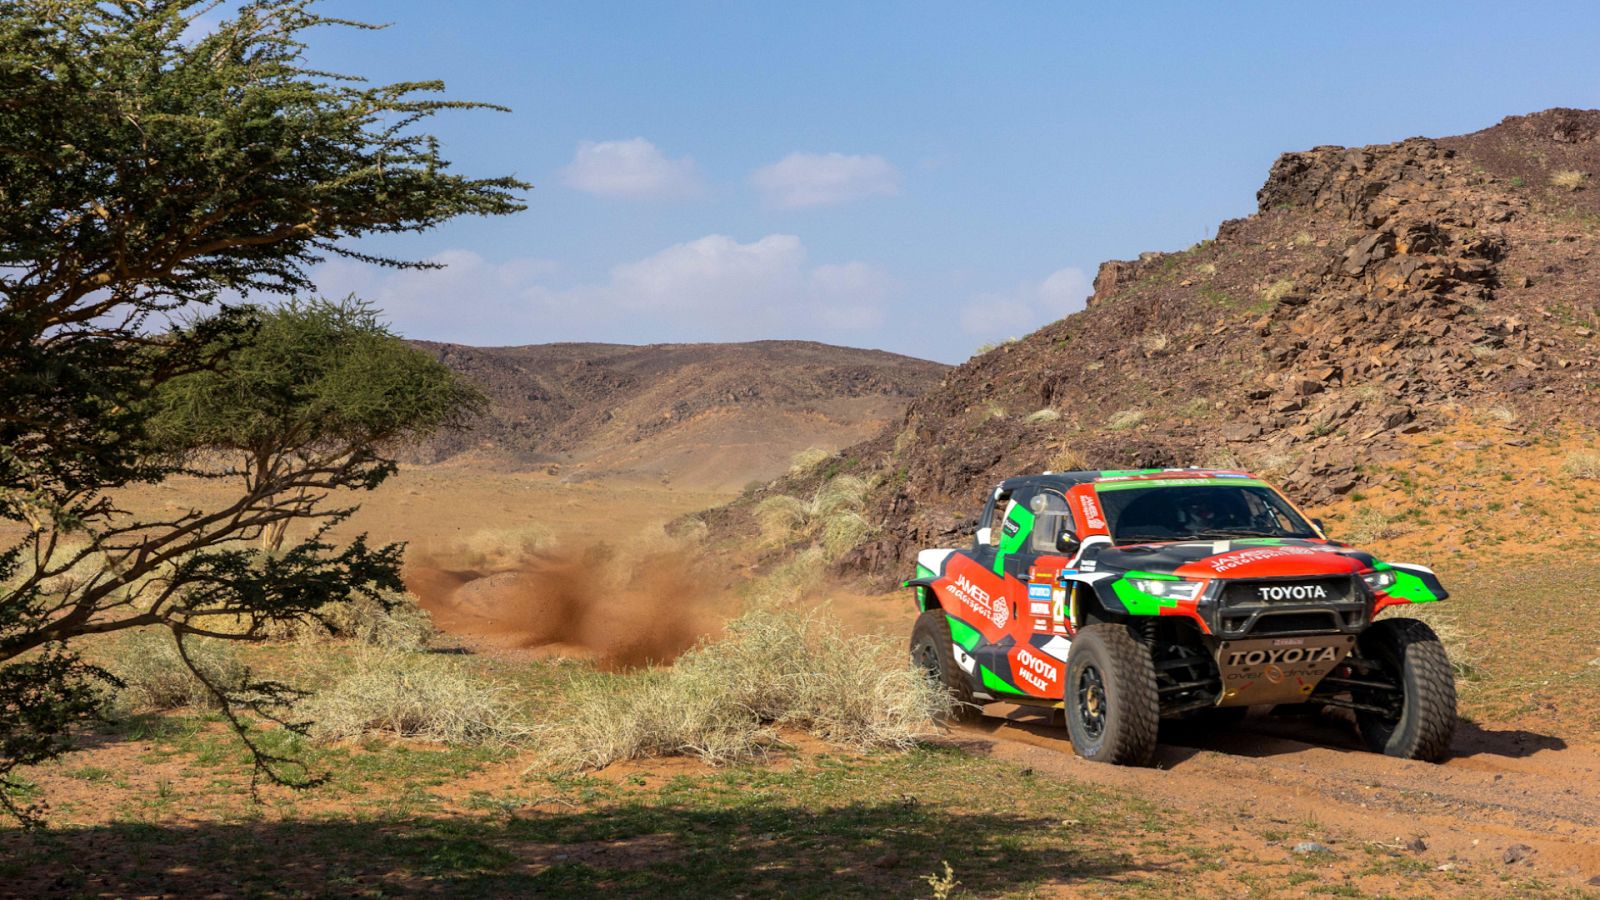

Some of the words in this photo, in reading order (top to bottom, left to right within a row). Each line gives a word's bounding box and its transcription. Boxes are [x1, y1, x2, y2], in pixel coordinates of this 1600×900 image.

[955, 574, 992, 610] JAMEEL
[1259, 585, 1327, 600] TOYOTA
[1017, 649, 1057, 682] TOYOTA
[1228, 646, 1338, 666] TOYOTA
[1019, 667, 1048, 691] HILUX
